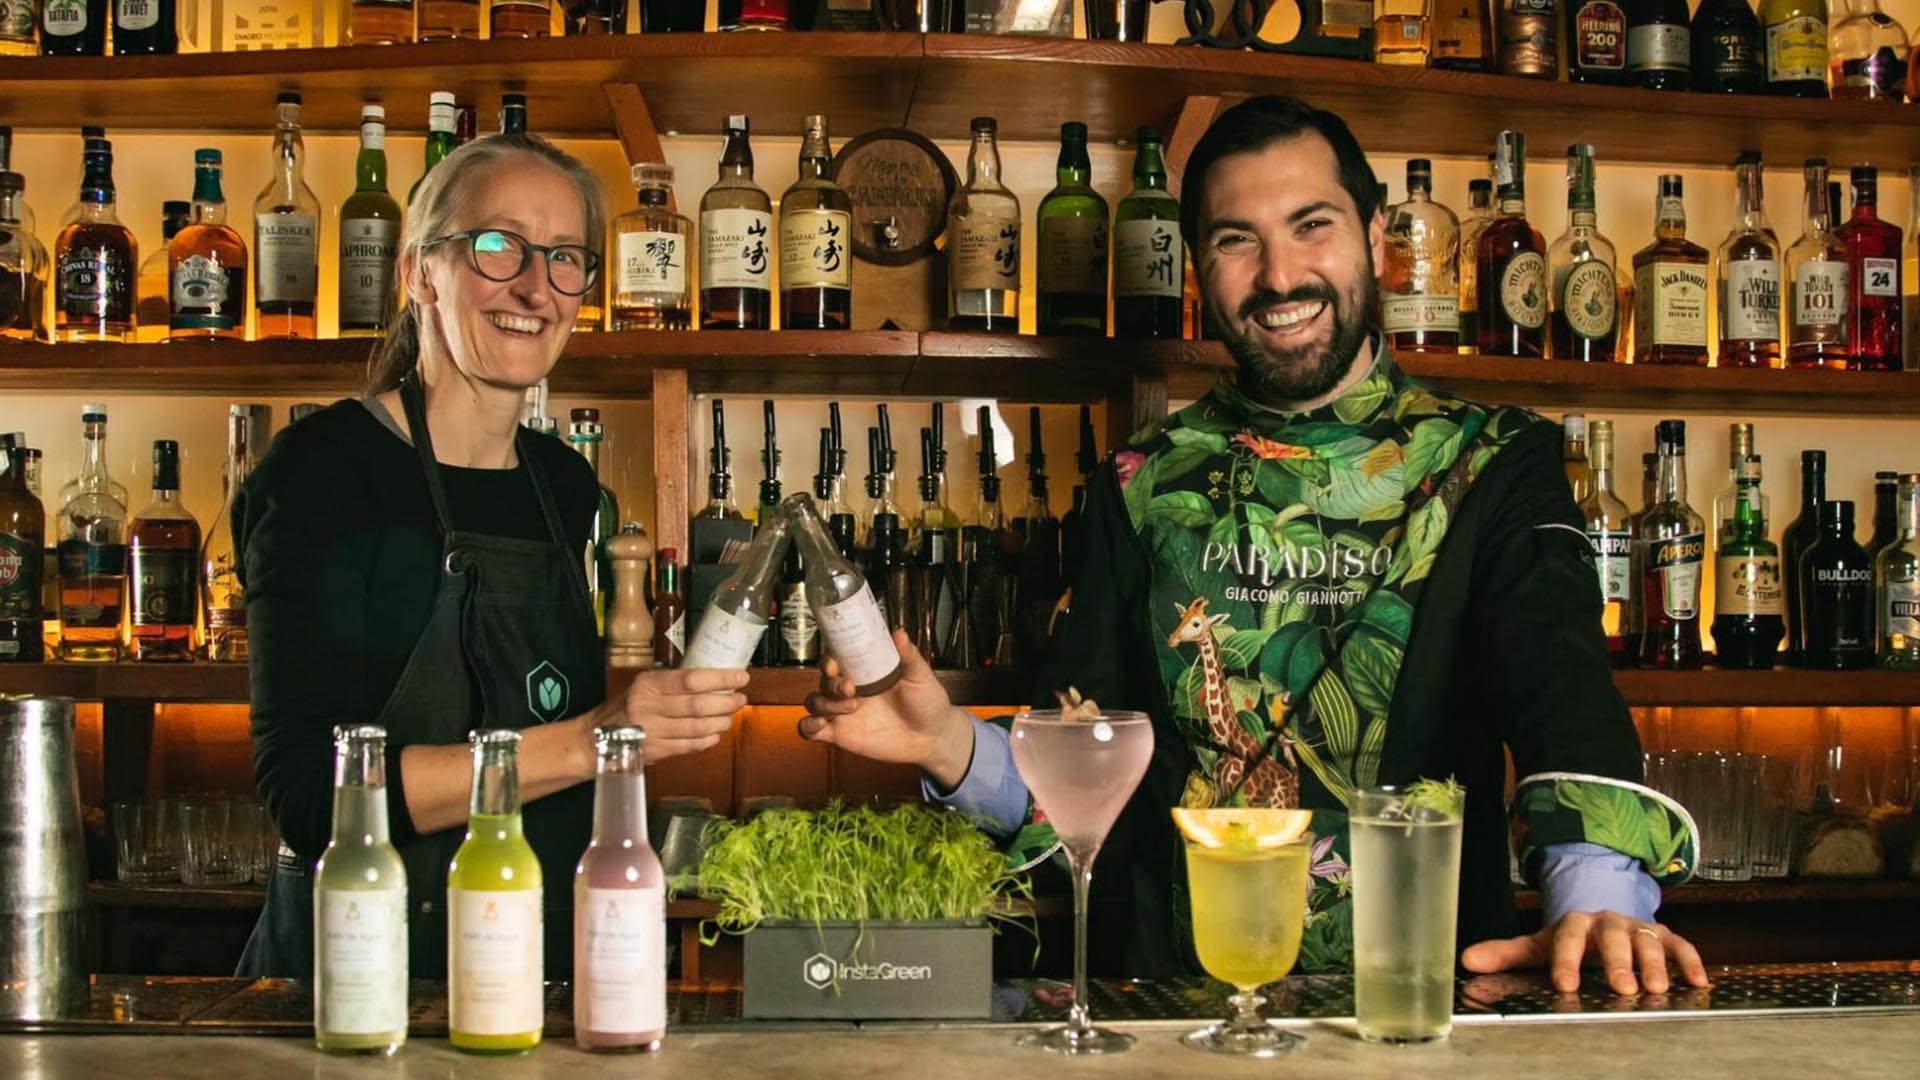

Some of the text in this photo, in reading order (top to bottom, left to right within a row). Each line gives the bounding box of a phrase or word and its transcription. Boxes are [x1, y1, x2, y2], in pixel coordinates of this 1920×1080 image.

[123, 4, 148, 16] D'AVET
[1582, 20, 1621, 33] HEERING
[1586, 33, 1616, 47] 200
[1712, 35, 1746, 45] TORR
[259, 225, 312, 236] TALISKER
[343, 243, 396, 258] APHROA
[741, 218, 769, 275] 山崎
[812, 219, 843, 273] 山崎
[627, 258, 637, 268] 17
[1147, 226, 1174, 287] 白州
[61, 260, 116, 275] CHIVAS REAL
[80, 273, 91, 284] 18
[360, 274, 373, 288] 10
[1661, 273, 1678, 289] JACK
[1748, 277, 1778, 293] WILD
[1808, 275, 1830, 283] WILD
[1871, 271, 1890, 287] 24
[1804, 283, 1833, 293] TURKEY
[1738, 289, 1780, 310] TURKE
[1804, 293, 1834, 310] 101
[1591, 537, 1630, 553] AMPA
[1657, 541, 1704, 563] APERO
[1202, 542, 1393, 587] PARADISO
[1225, 586, 1290, 604] GIACOMO
[840, 962, 932, 980] InstaGreen
